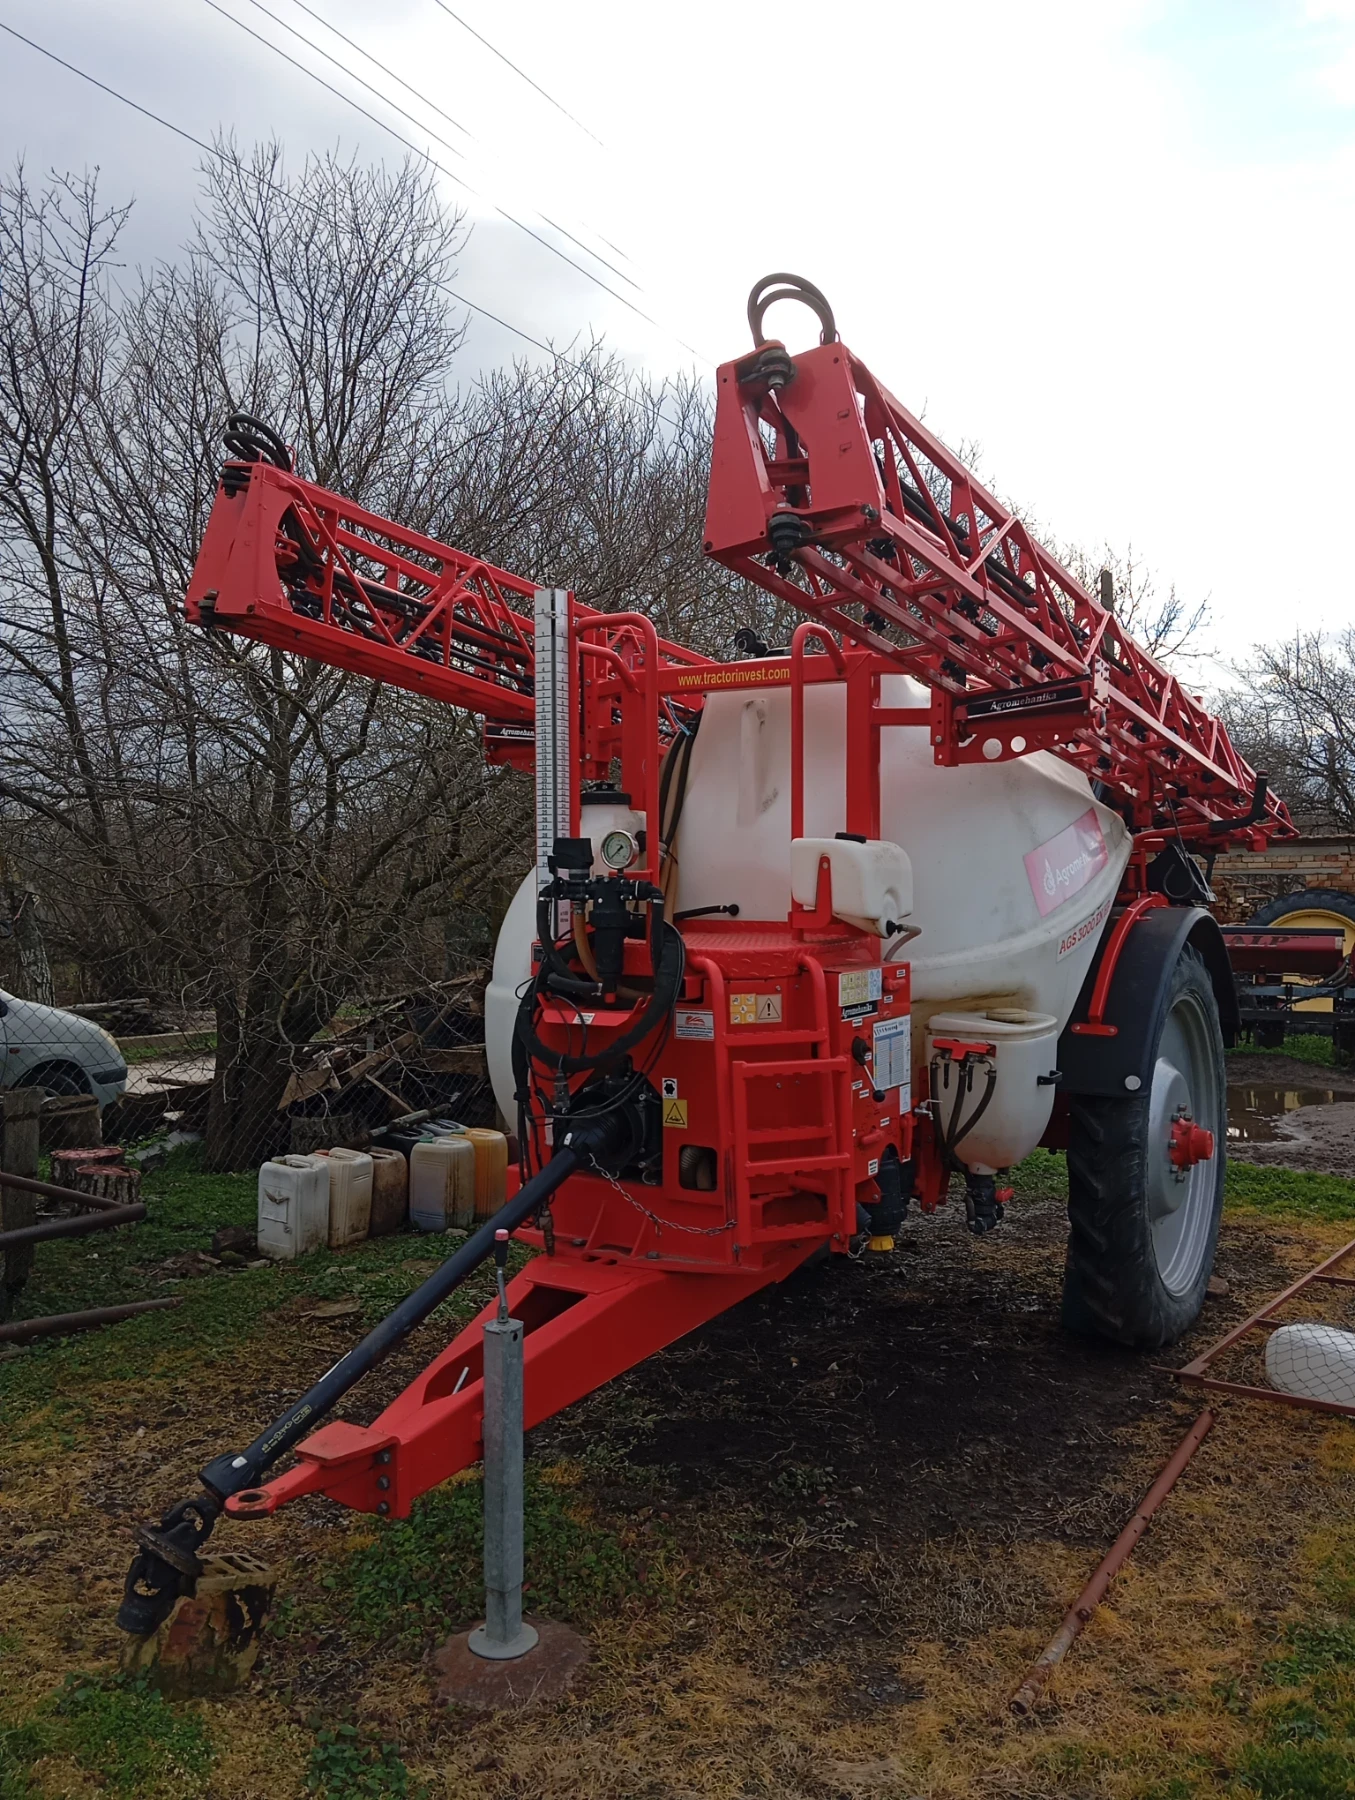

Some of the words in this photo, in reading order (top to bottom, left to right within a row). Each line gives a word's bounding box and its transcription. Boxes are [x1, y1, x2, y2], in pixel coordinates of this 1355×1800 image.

[677, 668, 790, 686] www.tractorinvest.com
[990, 693, 1057, 711] Agromehanika
[500, 728, 535, 737] Agromehan
[1059, 933, 1077, 954] AGS
